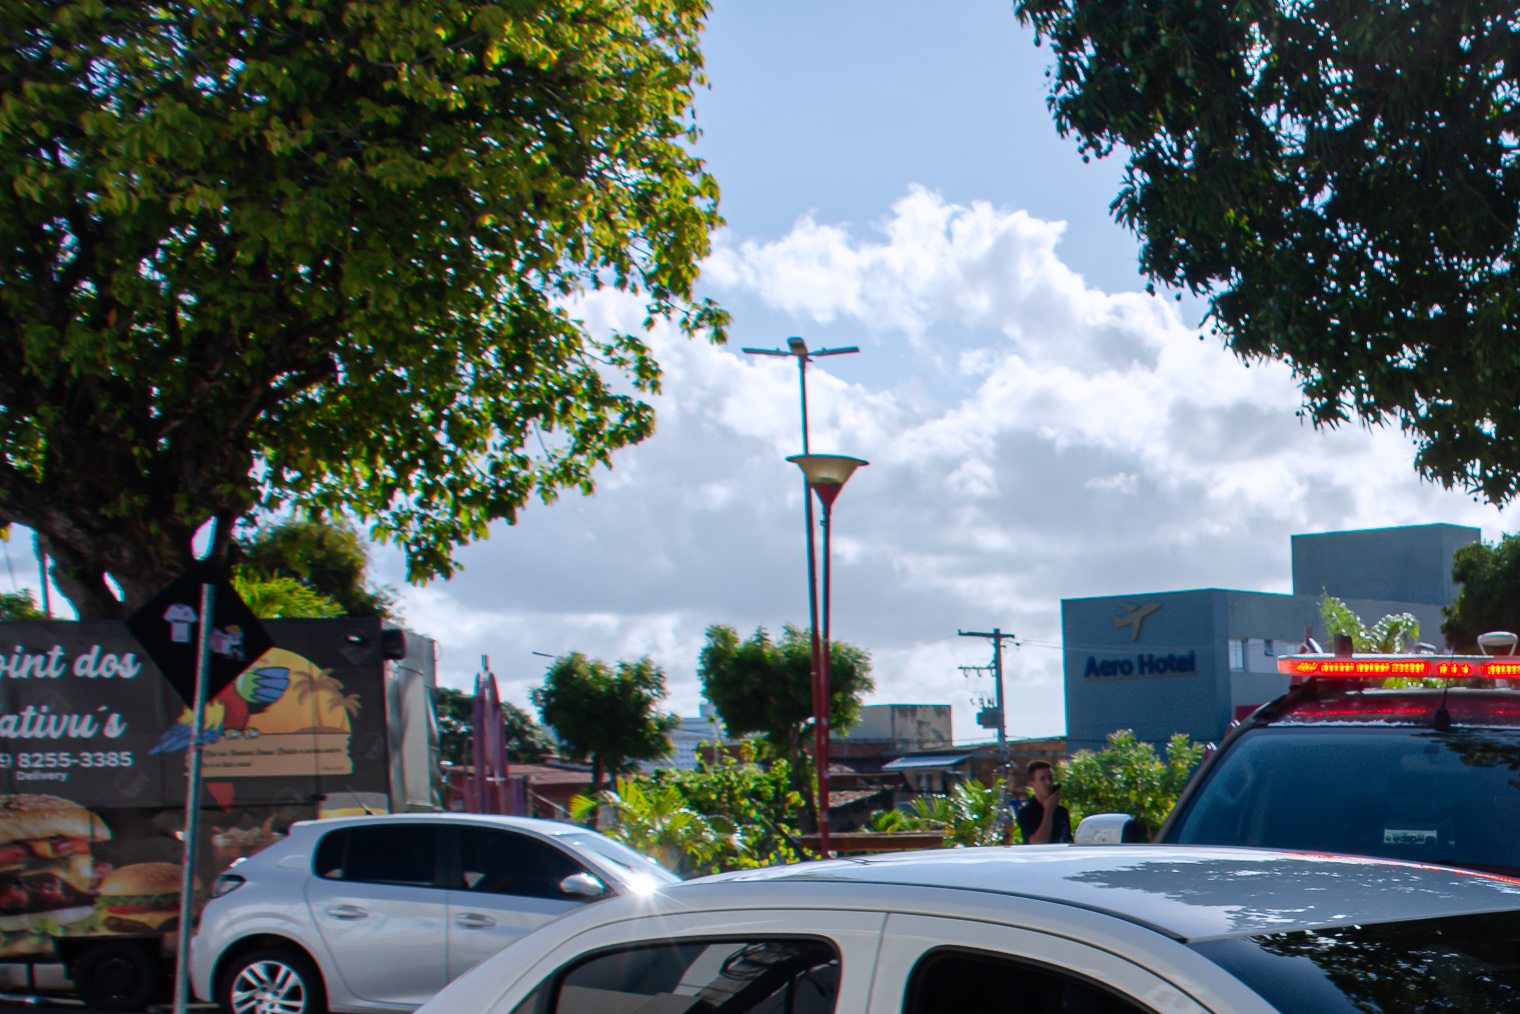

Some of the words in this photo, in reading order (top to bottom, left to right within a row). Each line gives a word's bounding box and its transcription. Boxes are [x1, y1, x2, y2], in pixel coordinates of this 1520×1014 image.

[73, 645, 142, 679] dos
[1084, 656, 1134, 678] Aero
[1137, 650, 1196, 676] Hotel
[17, 751, 134, 768] 8255-3385
[15, 769, 69, 782] Delivery
